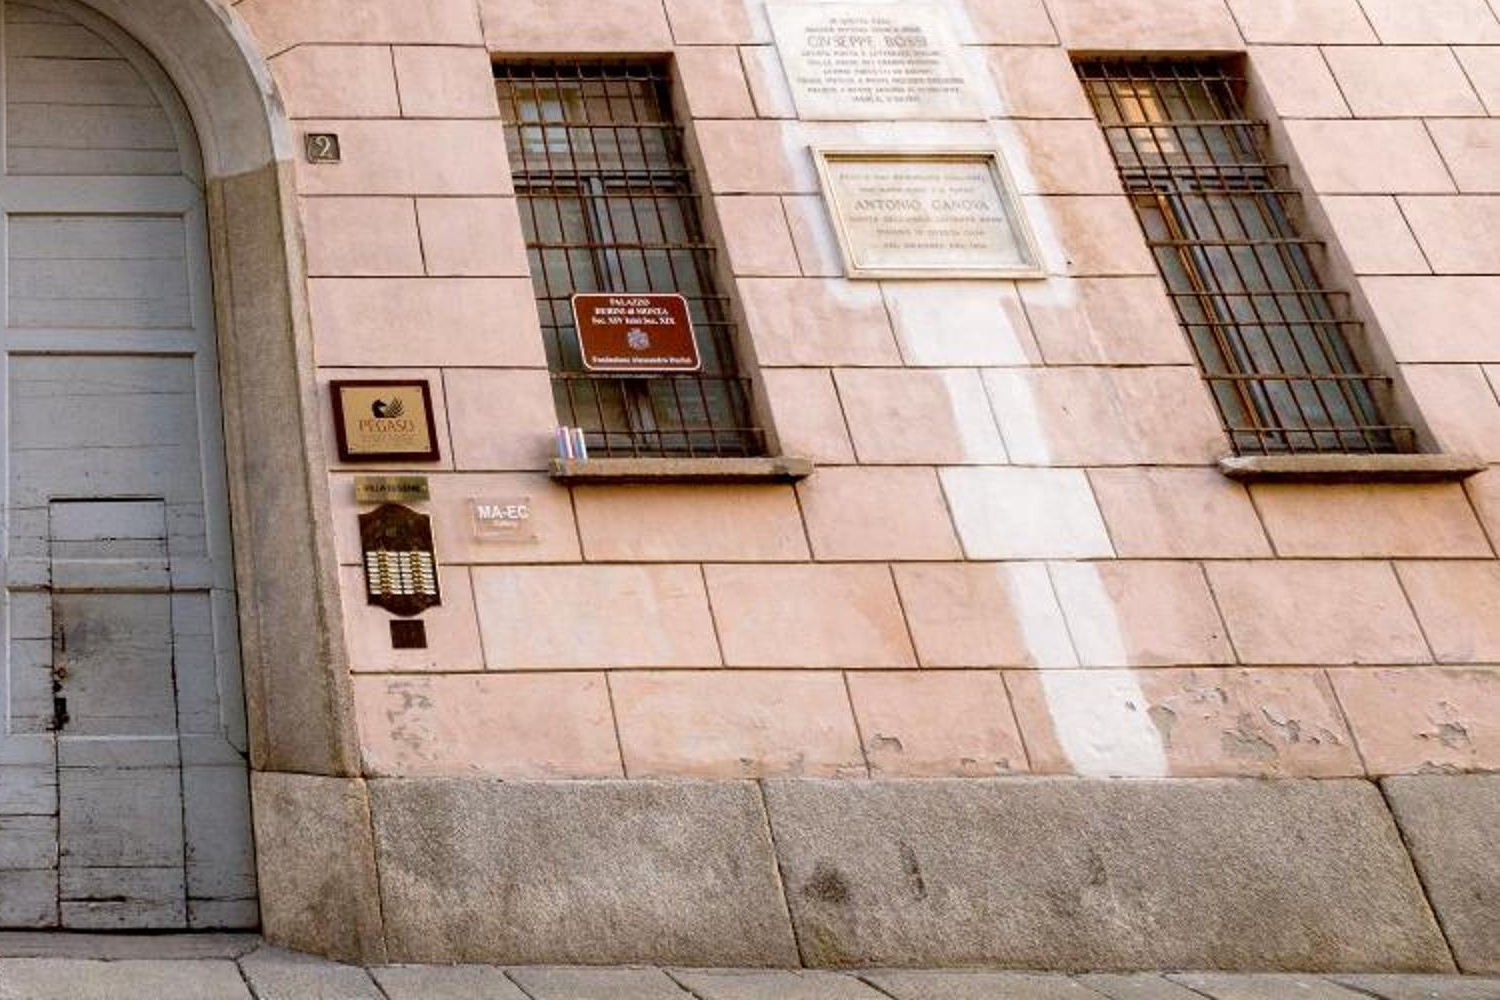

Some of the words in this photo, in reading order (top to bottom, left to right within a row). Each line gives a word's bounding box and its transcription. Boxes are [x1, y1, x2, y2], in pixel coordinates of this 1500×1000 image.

[315, 135, 333, 157] 2
[854, 199, 922, 211] ANTONIO
[931, 199, 990, 211] CANOVA
[609, 298, 651, 306] PALAZZO
[359, 419, 414, 432] PEGASO
